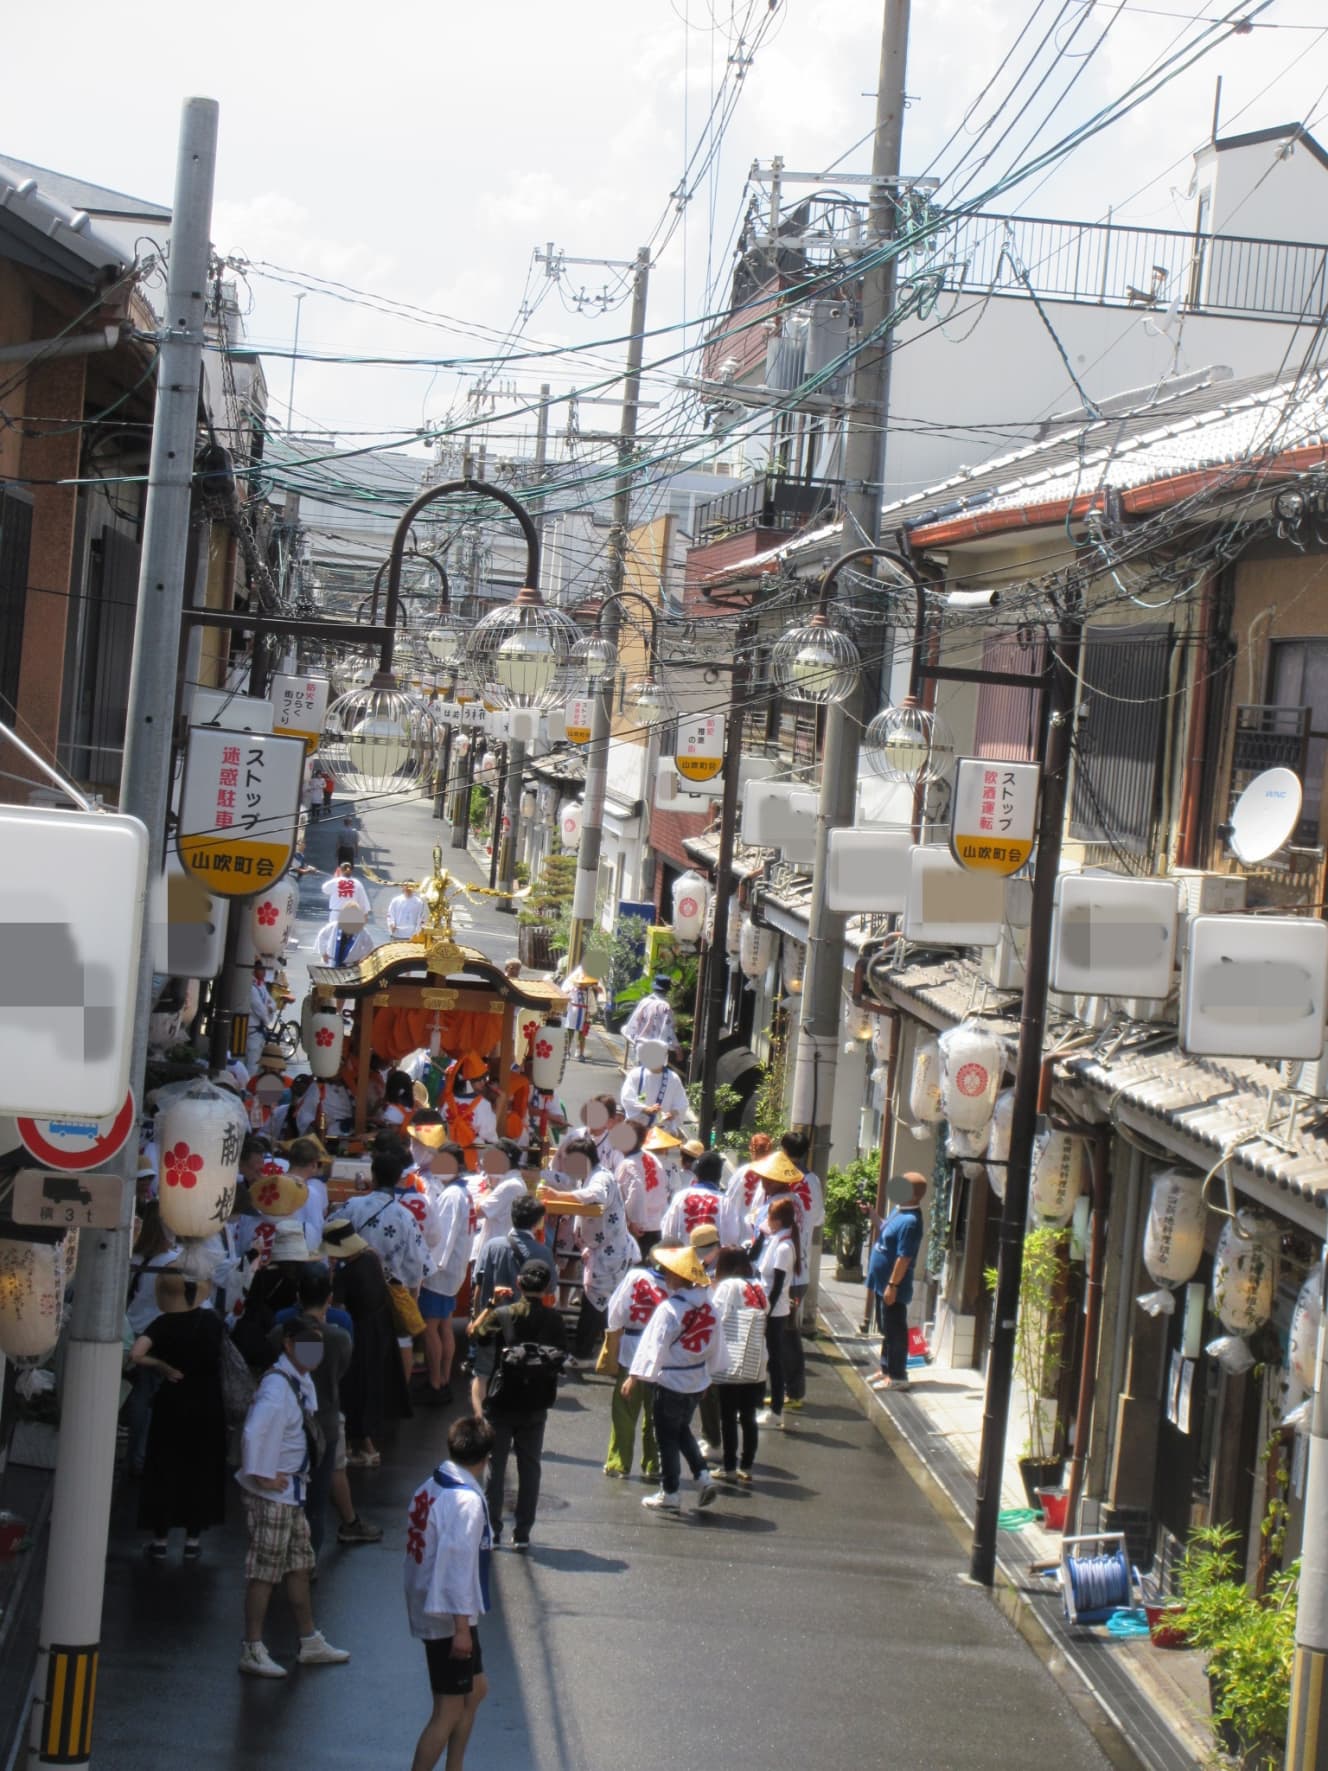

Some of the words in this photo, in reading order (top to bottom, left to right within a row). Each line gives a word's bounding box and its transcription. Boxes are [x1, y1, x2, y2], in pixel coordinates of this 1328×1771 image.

[215, 746, 241, 830] 迷惑駐車
[241, 749, 264, 830] ストップ
[979, 770, 998, 831] 飲酒運転
[999, 772, 1016, 831] ストップ
[192, 852, 275, 877] 山吹町会
[963, 845, 1022, 862] 山吹町会
[338, 879, 354, 898] 祭
[680, 1303, 716, 1353] 祭
